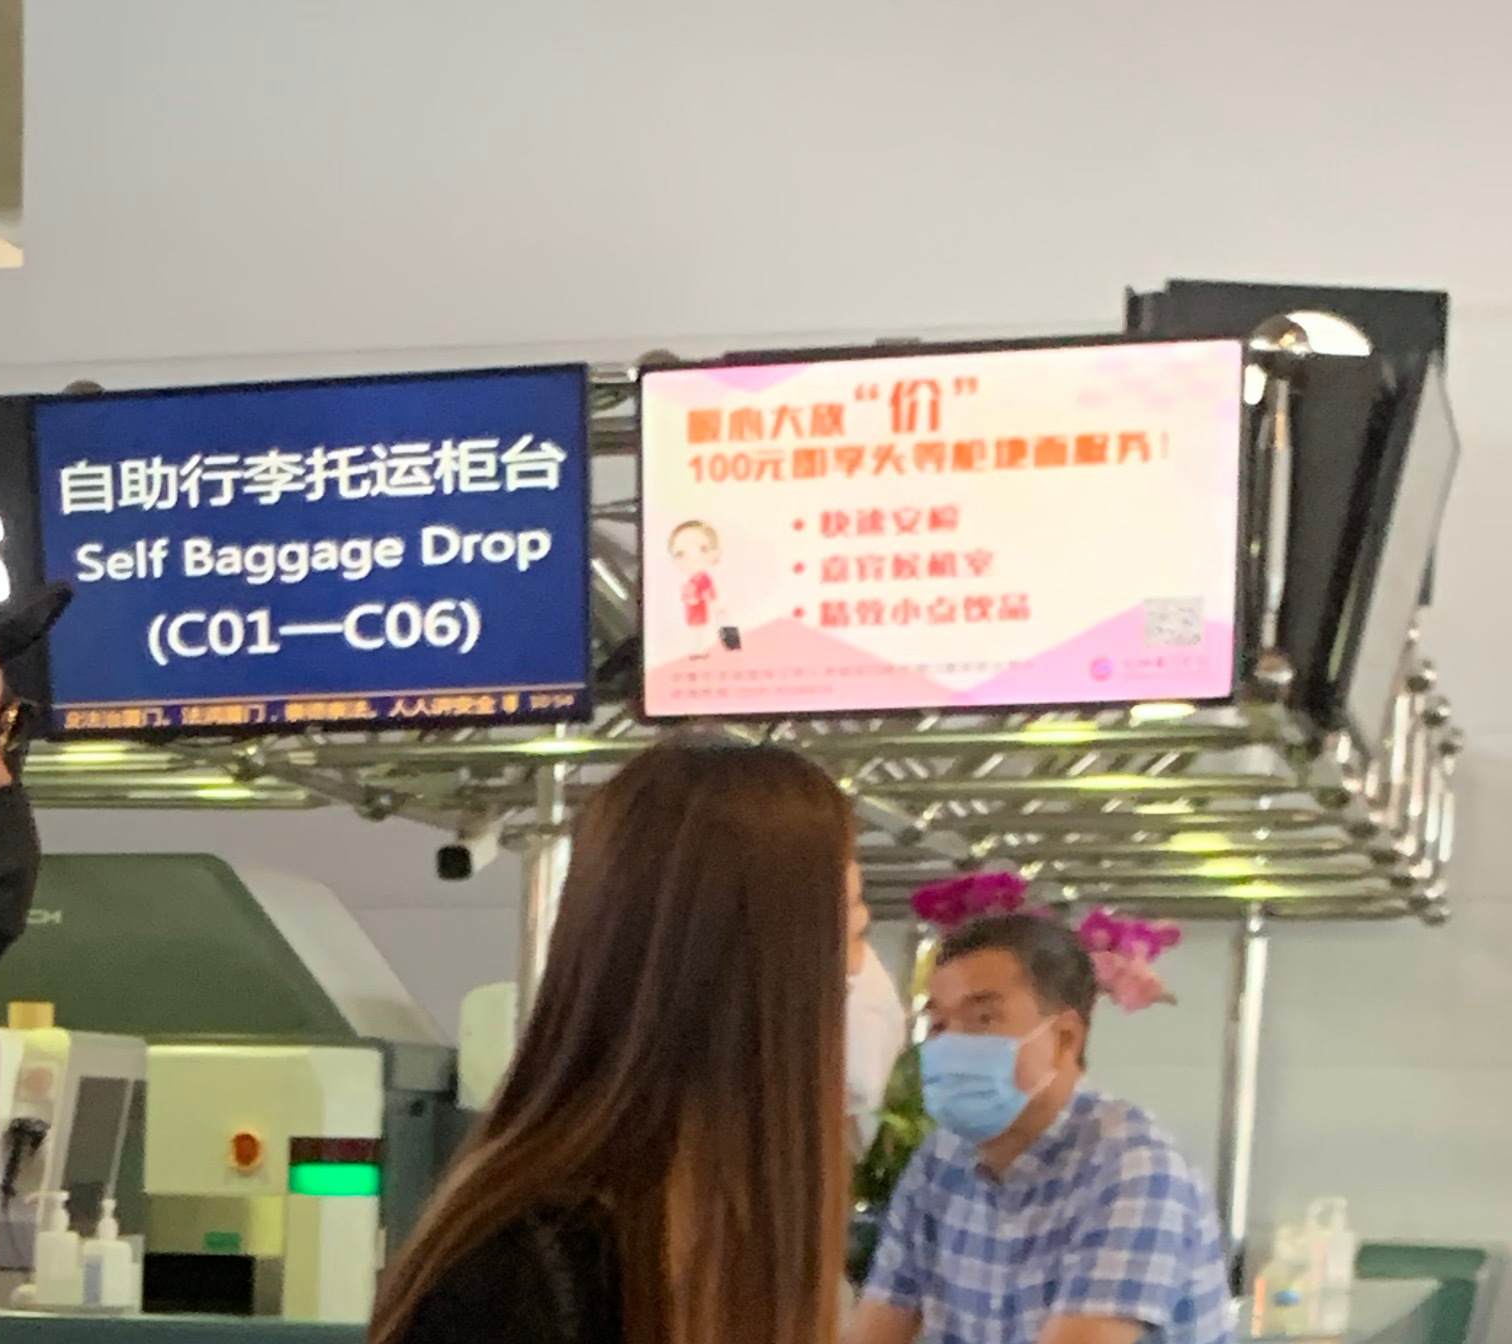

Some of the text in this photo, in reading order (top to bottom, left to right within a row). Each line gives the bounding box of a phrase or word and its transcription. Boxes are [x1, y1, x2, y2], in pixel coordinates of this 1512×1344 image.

[58, 433, 568, 516] 自助行李托运柜台
[75, 523, 554, 586] Self Baggage Drop
